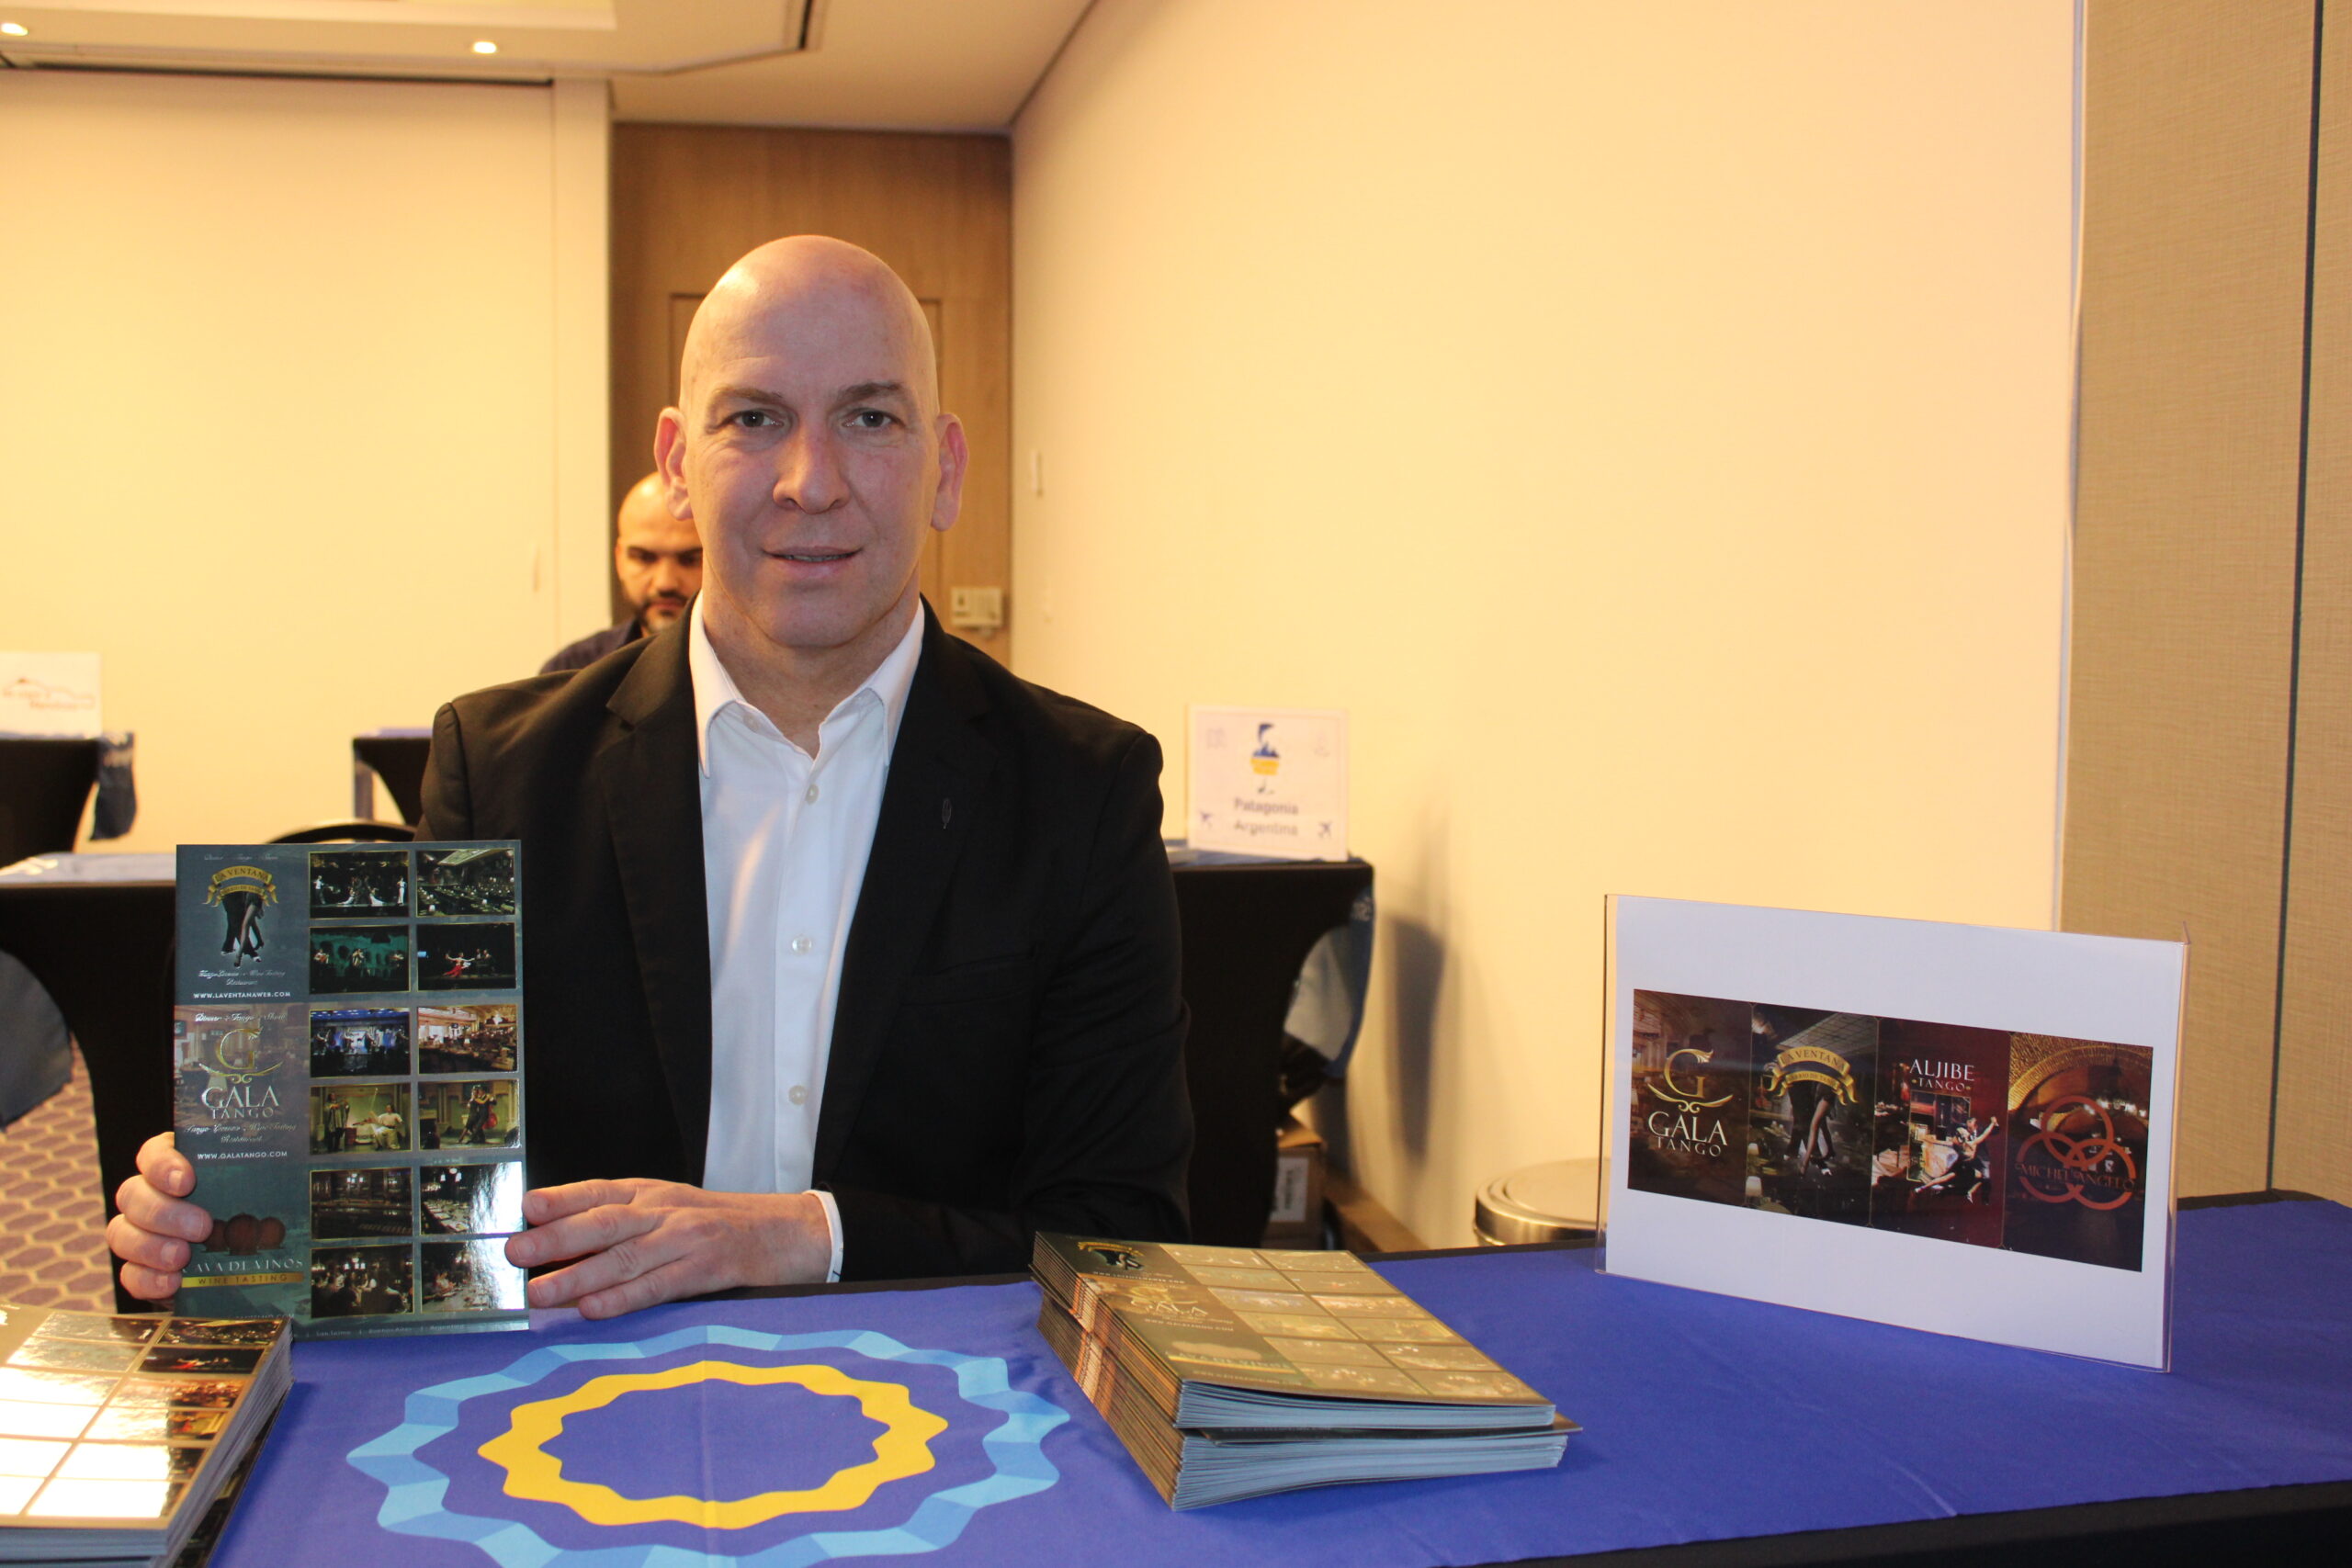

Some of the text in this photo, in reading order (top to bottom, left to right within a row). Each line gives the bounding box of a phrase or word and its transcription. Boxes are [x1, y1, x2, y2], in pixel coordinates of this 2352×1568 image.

[1234, 796, 1299, 817] Patagonia
[1234, 819, 1299, 837] Argentina
[228, 867, 269, 882] VENTANA
[193, 991, 291, 999] WWW.LAVENTANAWEB.COM
[1795, 1050, 1846, 1073] VENTANA
[1909, 1058, 1975, 1082] ALJIBE
[1918, 1077, 1966, 1092] TANGO
[201, 1085, 279, 1109] GALA
[210, 1107, 274, 1120] TANGO
[1648, 1111, 1728, 1146] GALA
[1655, 1136, 1722, 1157] TANGO
[197, 1150, 288, 1160] WWW.GALATANGO.COM
[254, 1258, 303, 1270] VINOS
[198, 1273, 288, 1285] WINE TASTING
